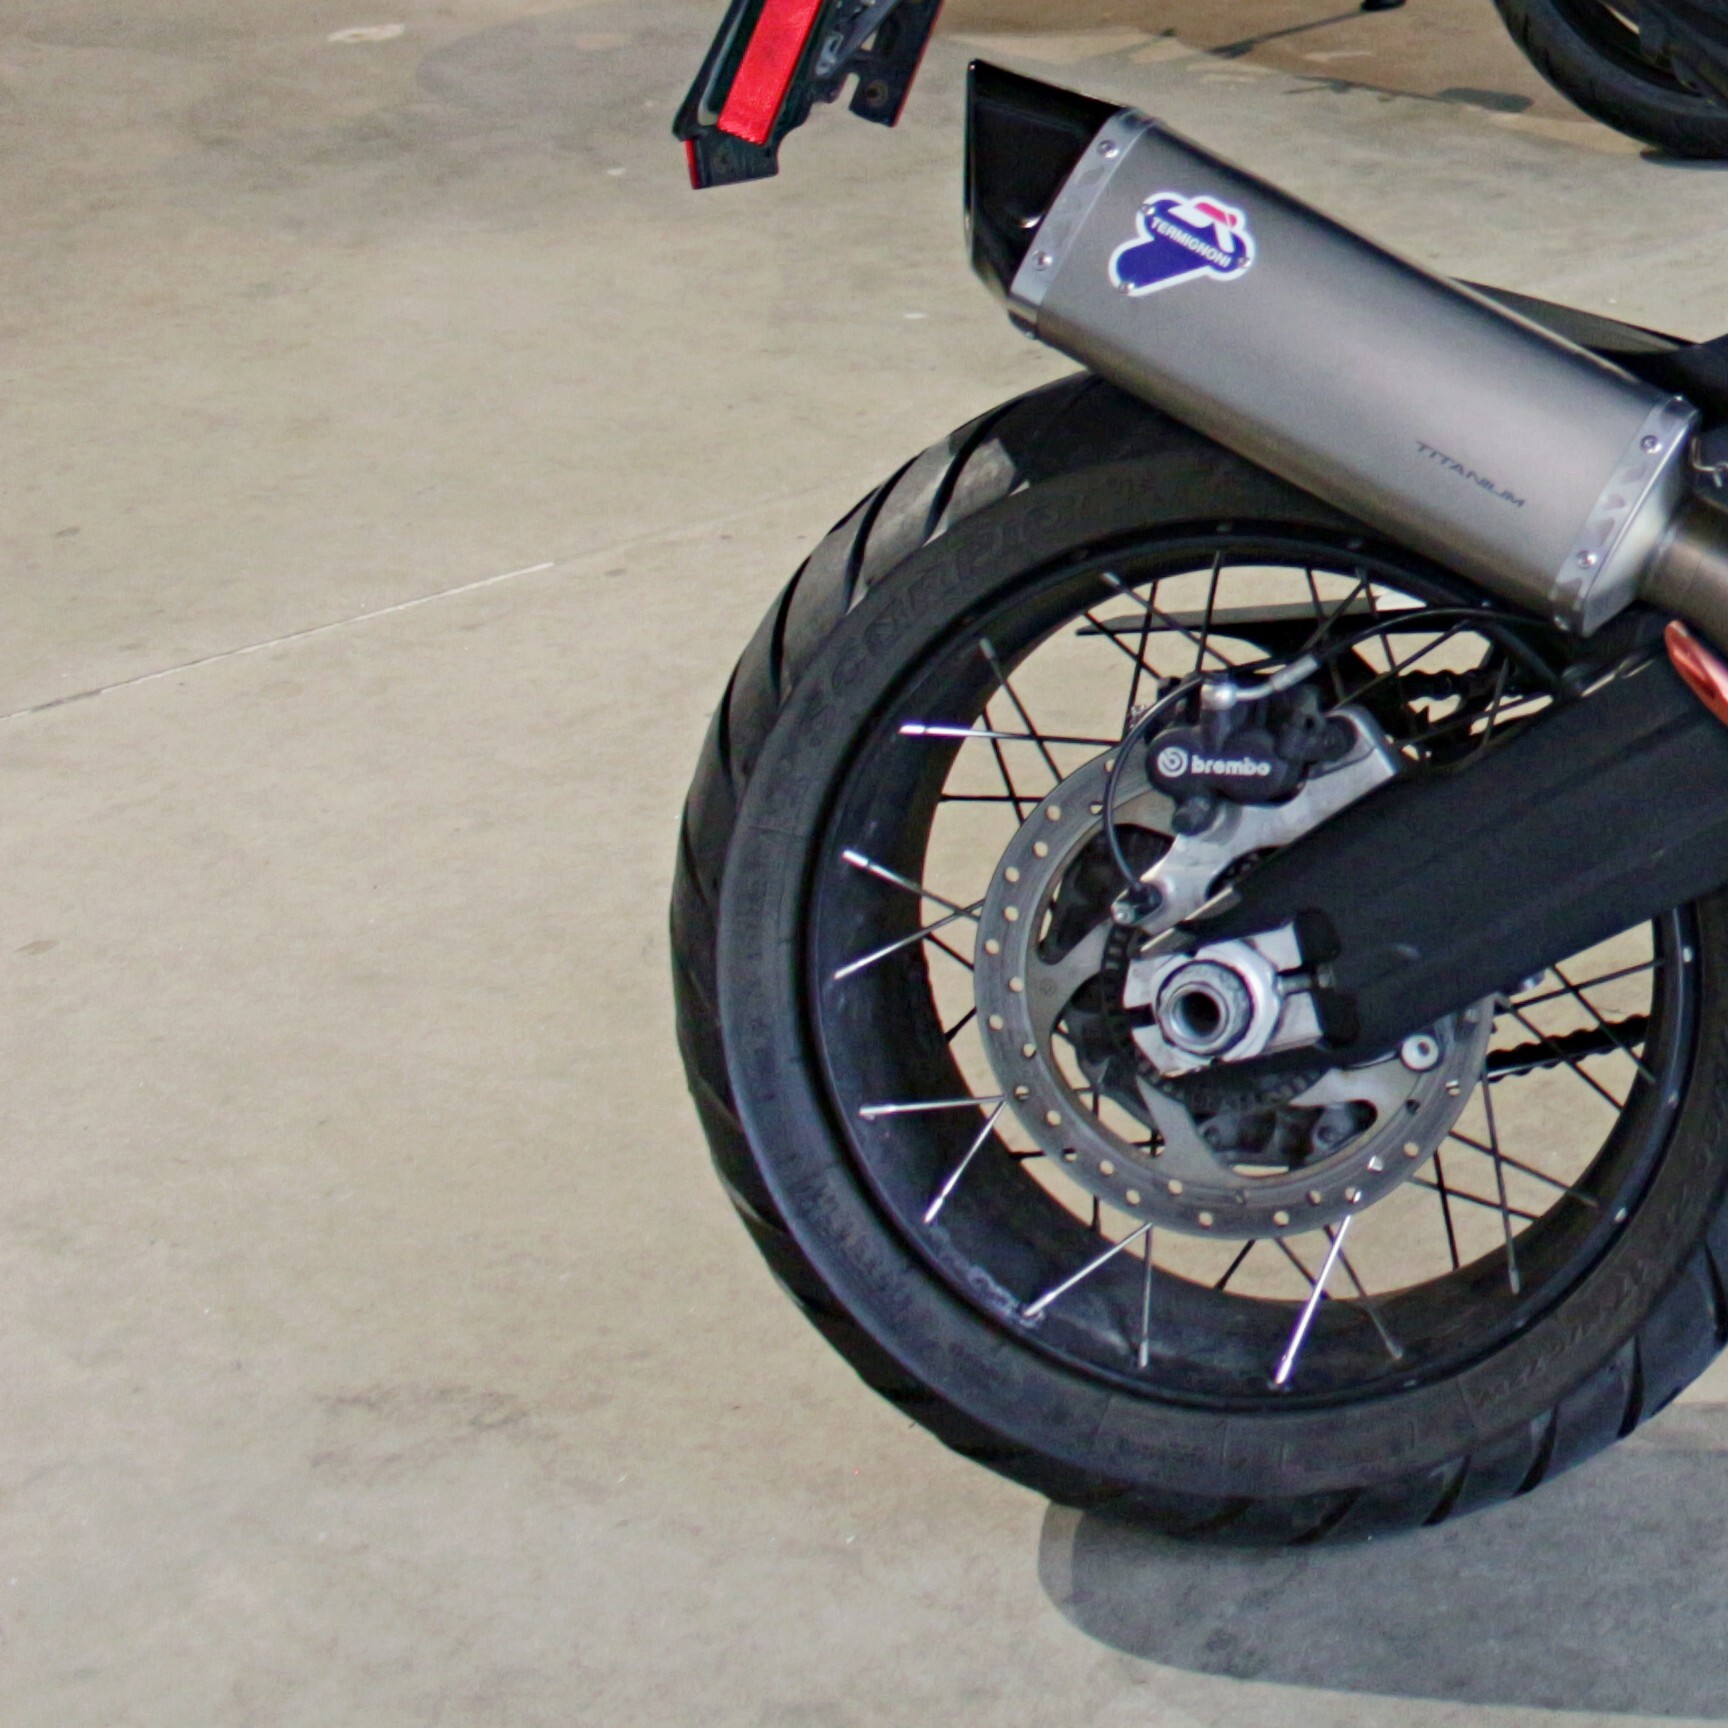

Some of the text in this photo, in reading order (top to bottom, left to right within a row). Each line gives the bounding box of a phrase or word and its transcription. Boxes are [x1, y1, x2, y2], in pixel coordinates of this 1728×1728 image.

[1150, 215, 1233, 269] TERMIGNONI
[1415, 440, 1526, 508] TITANIUM
[1191, 754, 1271, 777] brembo
